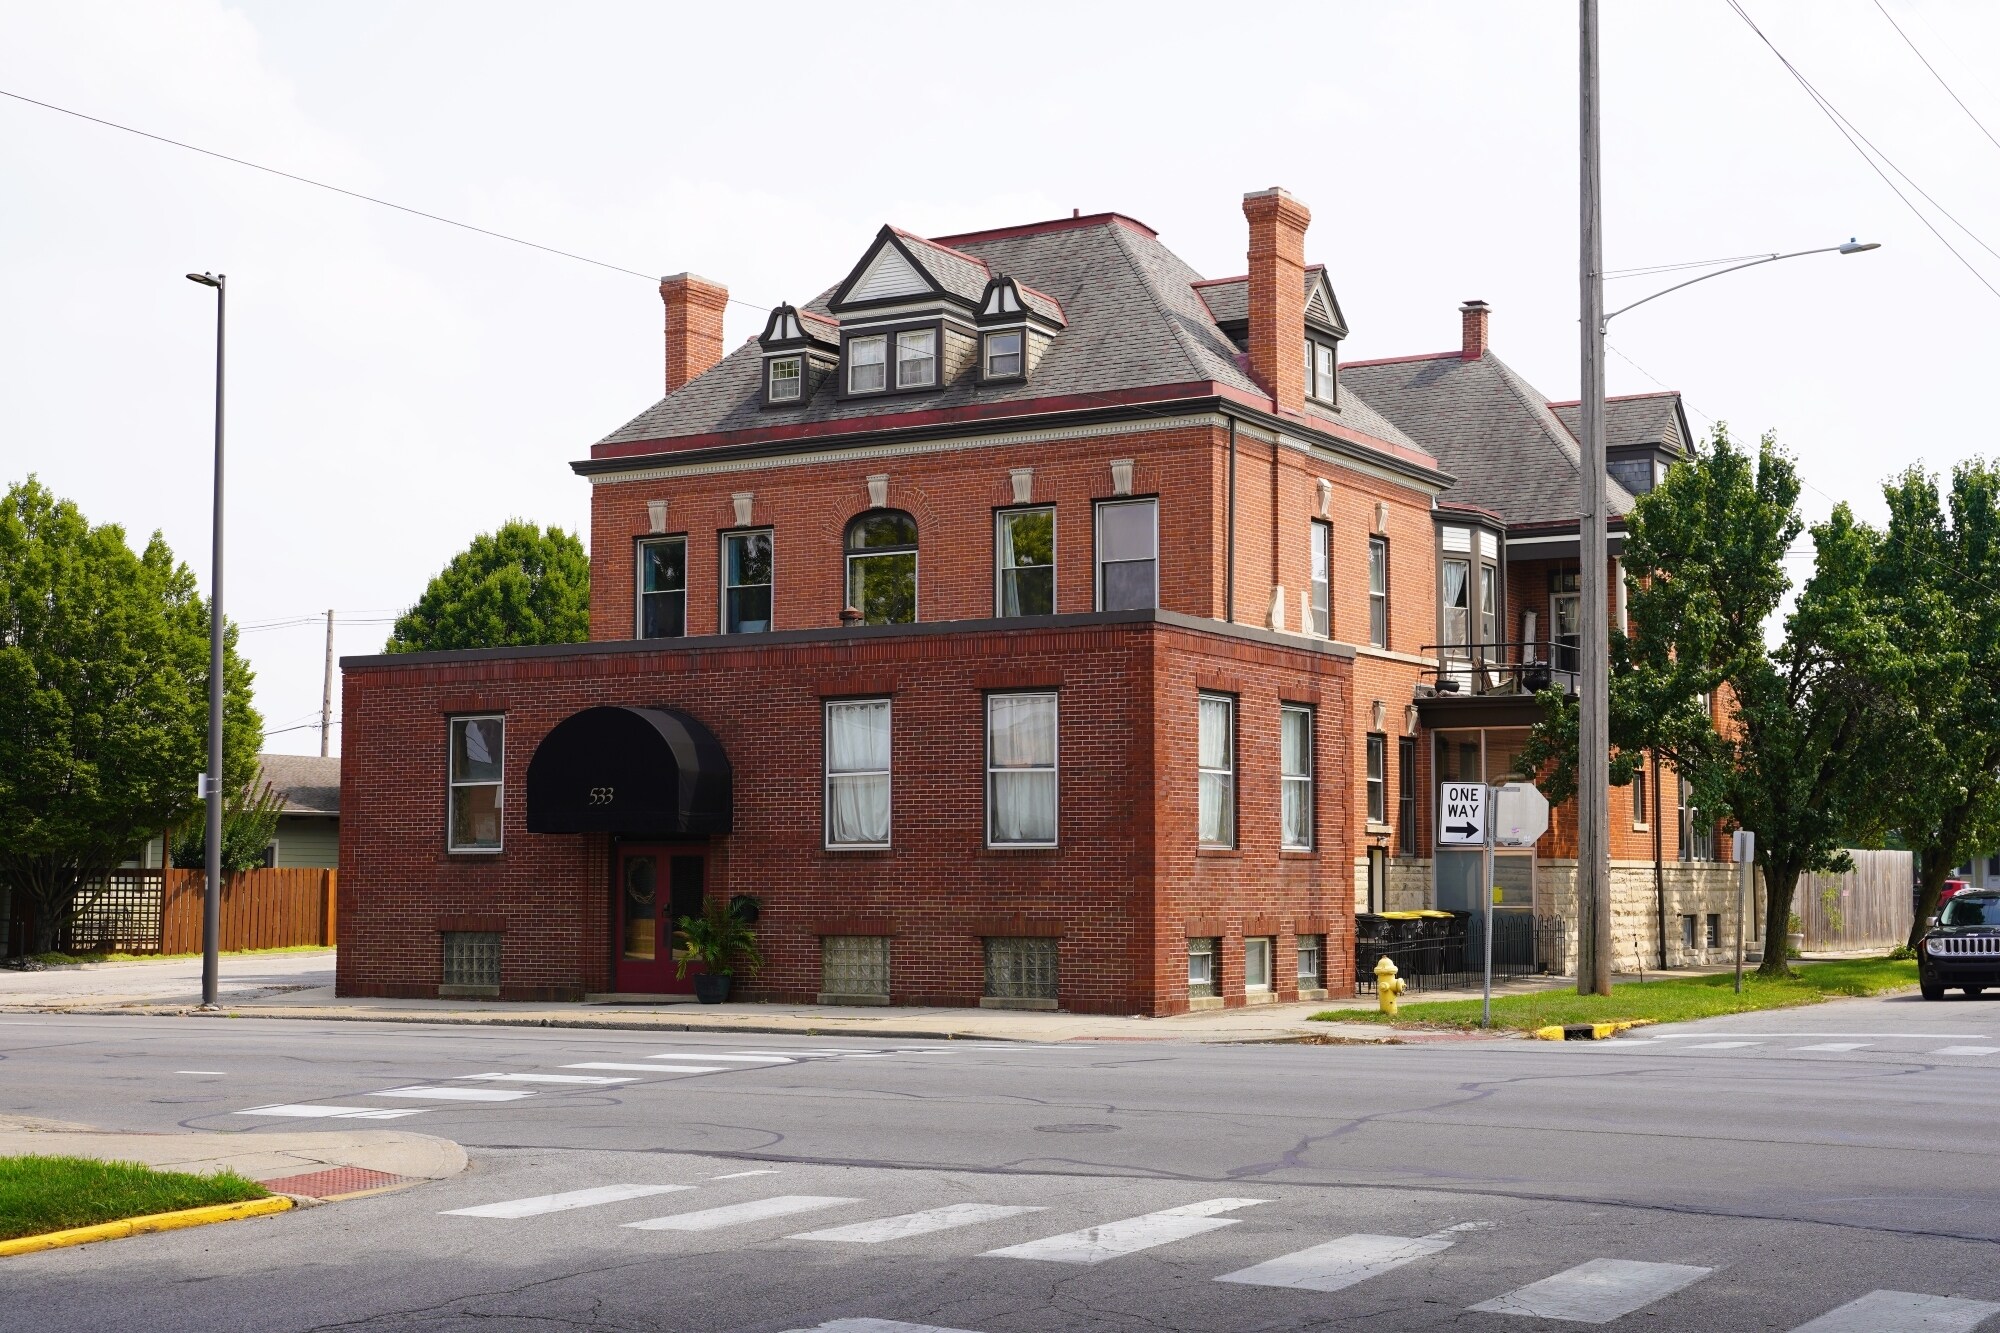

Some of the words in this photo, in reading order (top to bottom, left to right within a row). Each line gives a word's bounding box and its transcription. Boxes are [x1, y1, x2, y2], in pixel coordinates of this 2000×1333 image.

[588, 787, 614, 805] 533
[1449, 787, 1479, 802] ONE
[1447, 804, 1480, 818] WAY
